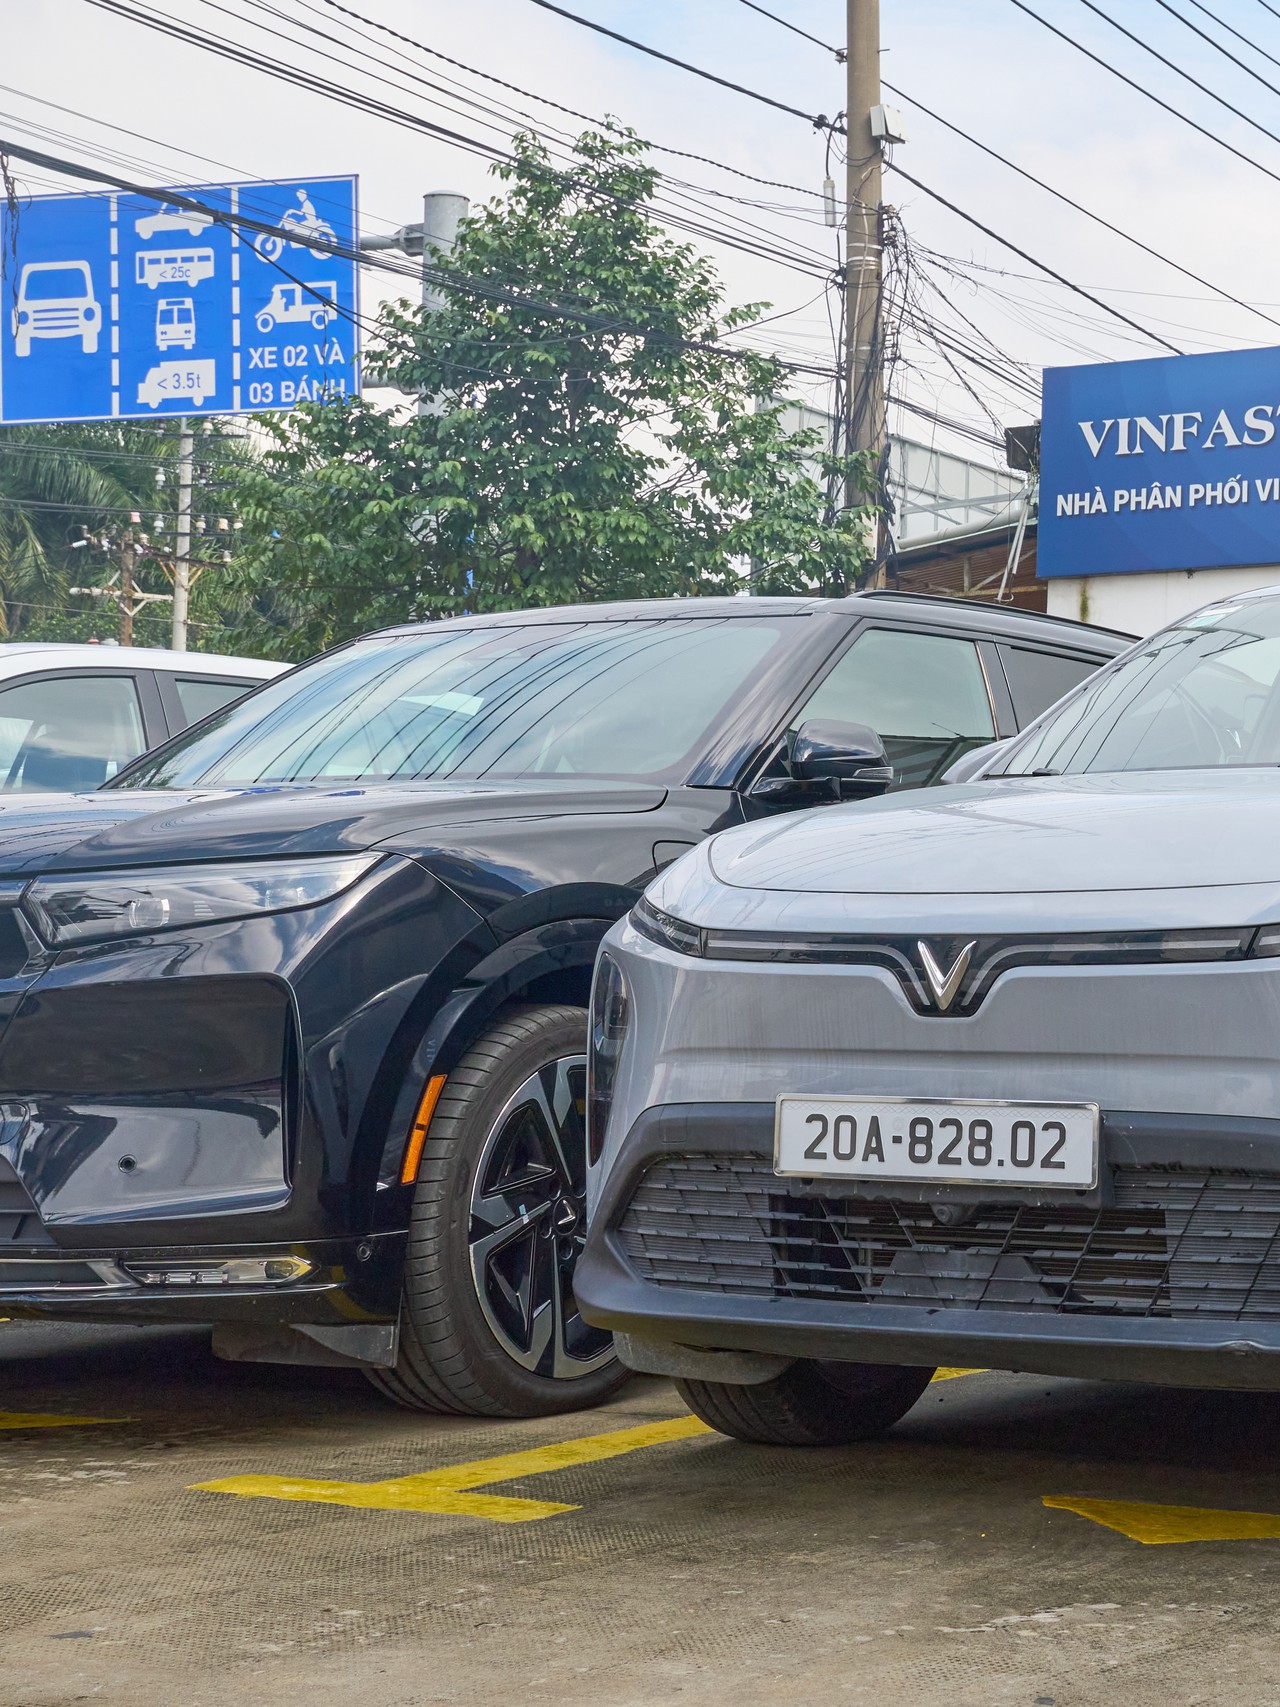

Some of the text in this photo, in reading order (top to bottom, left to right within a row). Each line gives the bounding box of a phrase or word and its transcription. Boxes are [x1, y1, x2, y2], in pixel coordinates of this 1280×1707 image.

[170, 266, 191, 279] 25c
[248, 337, 345, 369] XE 02 VÀ
[172, 372, 201, 390] 3.5t
[249, 374, 346, 404] 03 BÁNH
[1056, 486, 1108, 517] NHÀ
[1113, 481, 1182, 512] PHÂN
[1188, 474, 1249, 507] PHỐI
[803, 1113, 1066, 1170] 20A-828.02
